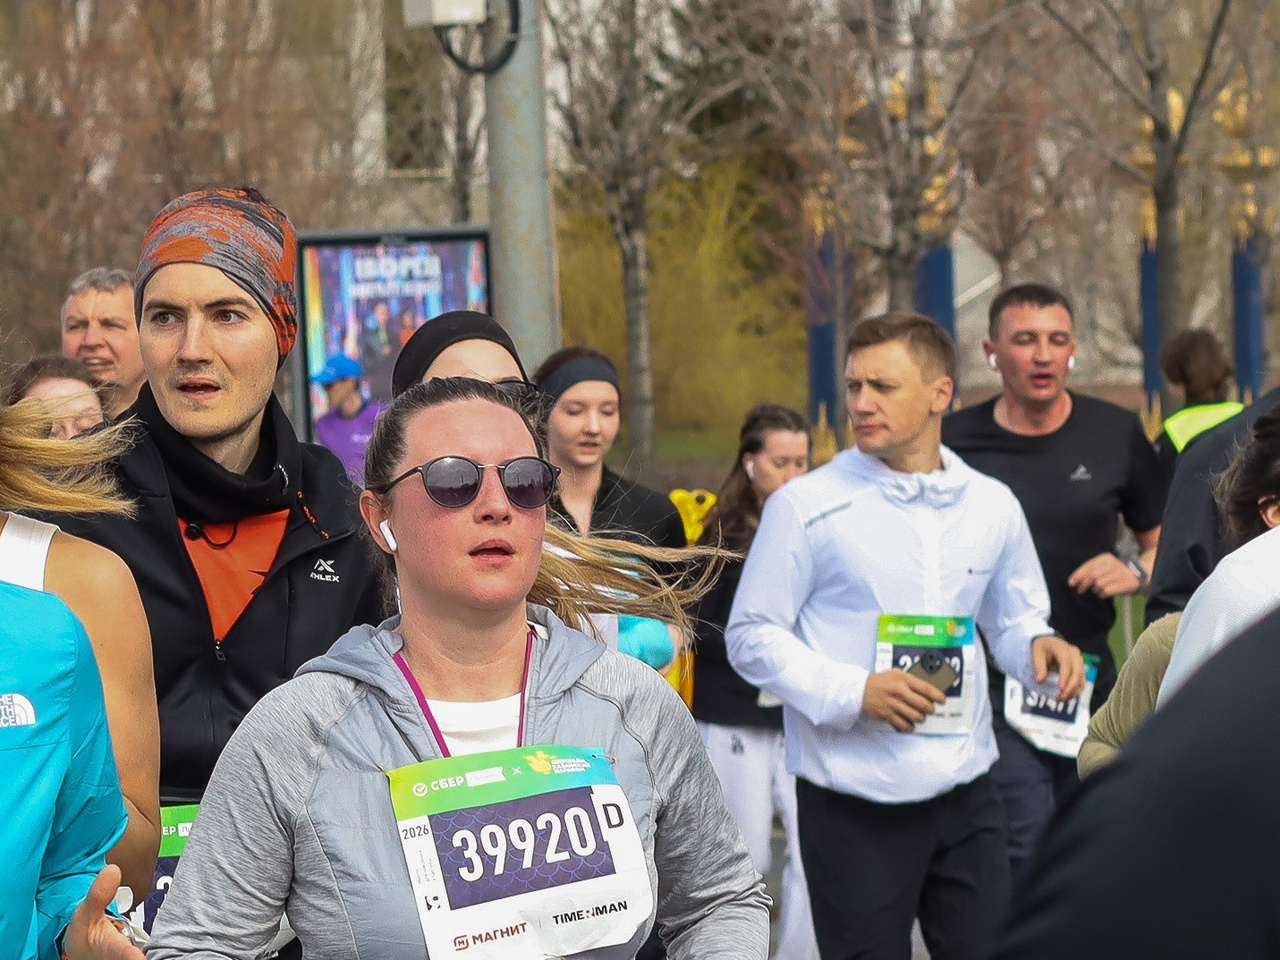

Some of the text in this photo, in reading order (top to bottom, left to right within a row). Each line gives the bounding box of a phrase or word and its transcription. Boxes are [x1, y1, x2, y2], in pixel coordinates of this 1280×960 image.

[430, 776, 465, 791] СБЕР
[602, 803, 625, 829] D
[402, 824, 430, 840] 2026
[452, 806, 597, 882] 39920
[472, 922, 528, 946] МАГНИТ
